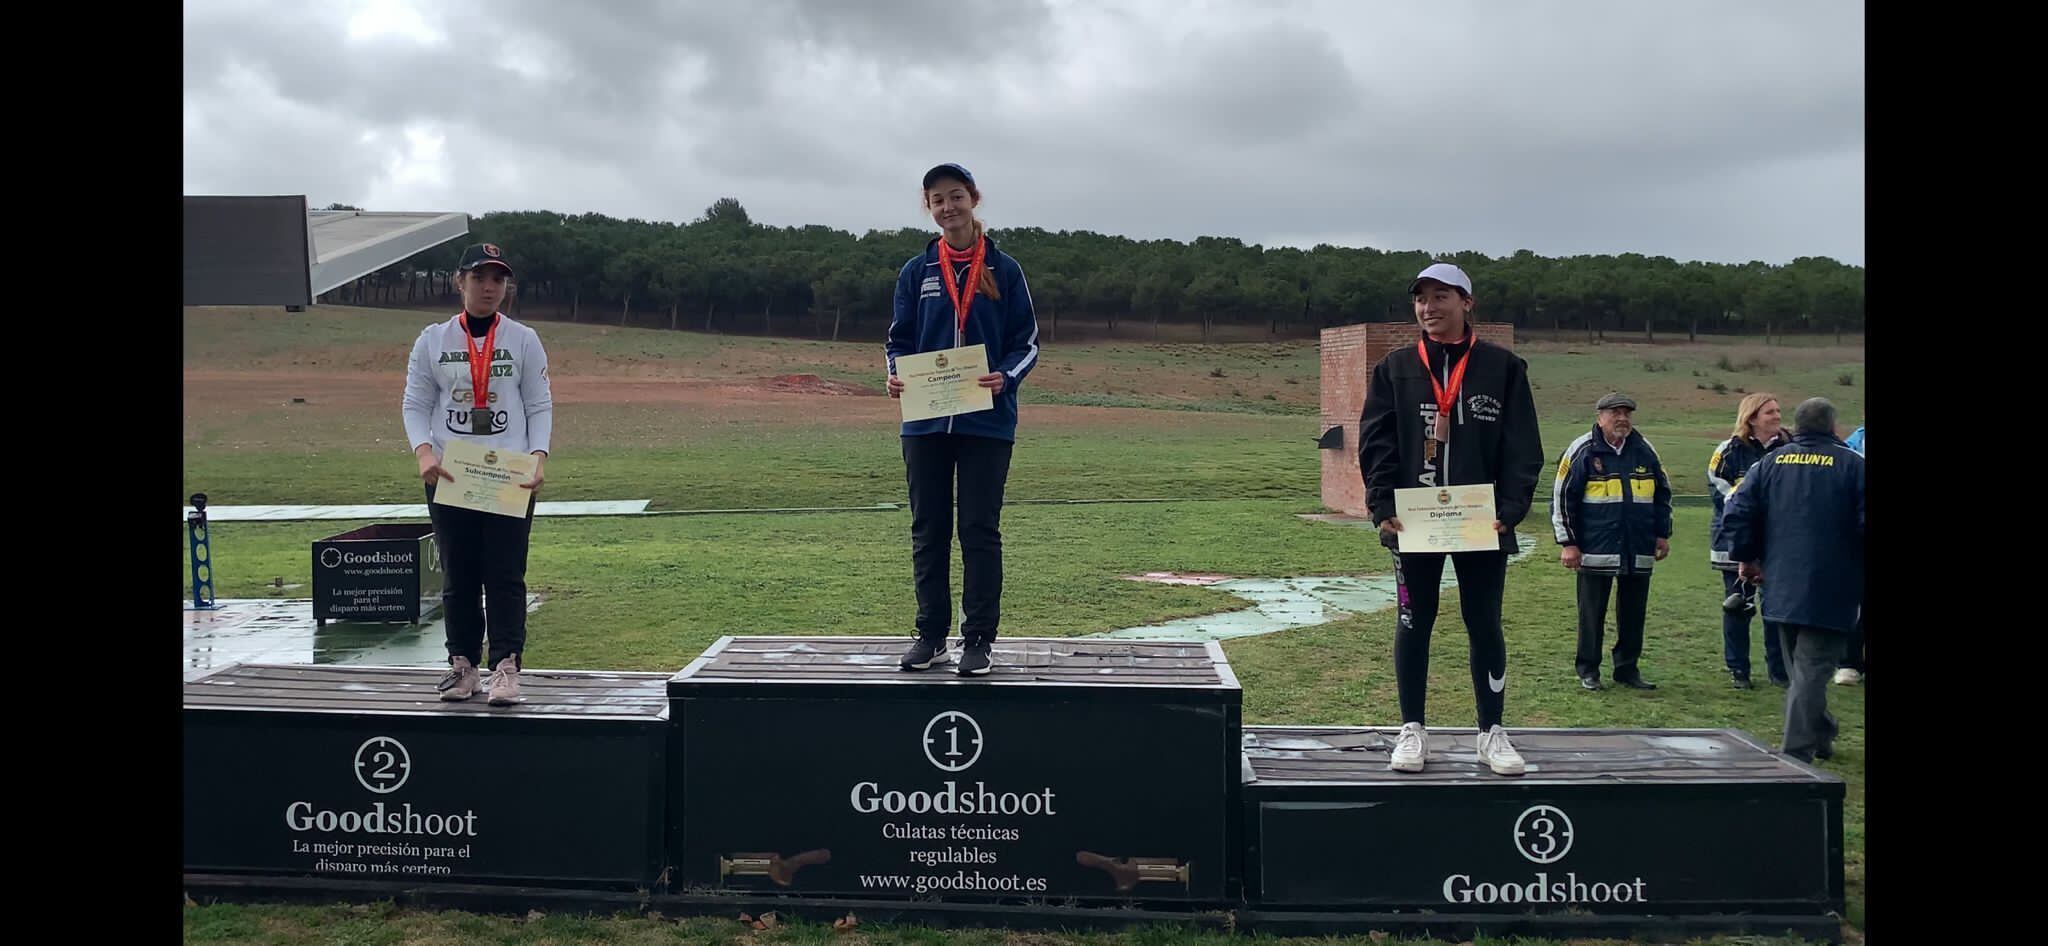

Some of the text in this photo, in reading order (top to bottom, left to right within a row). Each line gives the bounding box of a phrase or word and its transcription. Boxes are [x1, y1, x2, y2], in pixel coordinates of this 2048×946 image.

[927, 373, 961, 383] Campeón
[1775, 453, 1834, 466] CATALUNYA
[464, 467, 511, 481] Subcampeón
[344, 552, 413, 564] Goodshoot
[344, 567, 413, 576] www.goodshoot.es
[332, 587, 403, 597] La mejor precisión
[329, 604, 359, 613] disparo
[353, 597, 371, 605] para
[944, 727, 963, 755] 1
[372, 751, 396, 778] 2
[850, 781, 1056, 815] Goodshoot
[286, 801, 478, 836] Goodshoot
[882, 823, 1019, 840] Culatas técnicas
[1531, 818, 1556, 854] 3
[293, 840, 470, 859] La mejor precisión para el
[910, 847, 997, 866] regulables
[315, 859, 450, 875] disparo más certero
[859, 870, 1047, 893] www.goodshoot.es
[1443, 872, 1648, 903] Goodshoot
